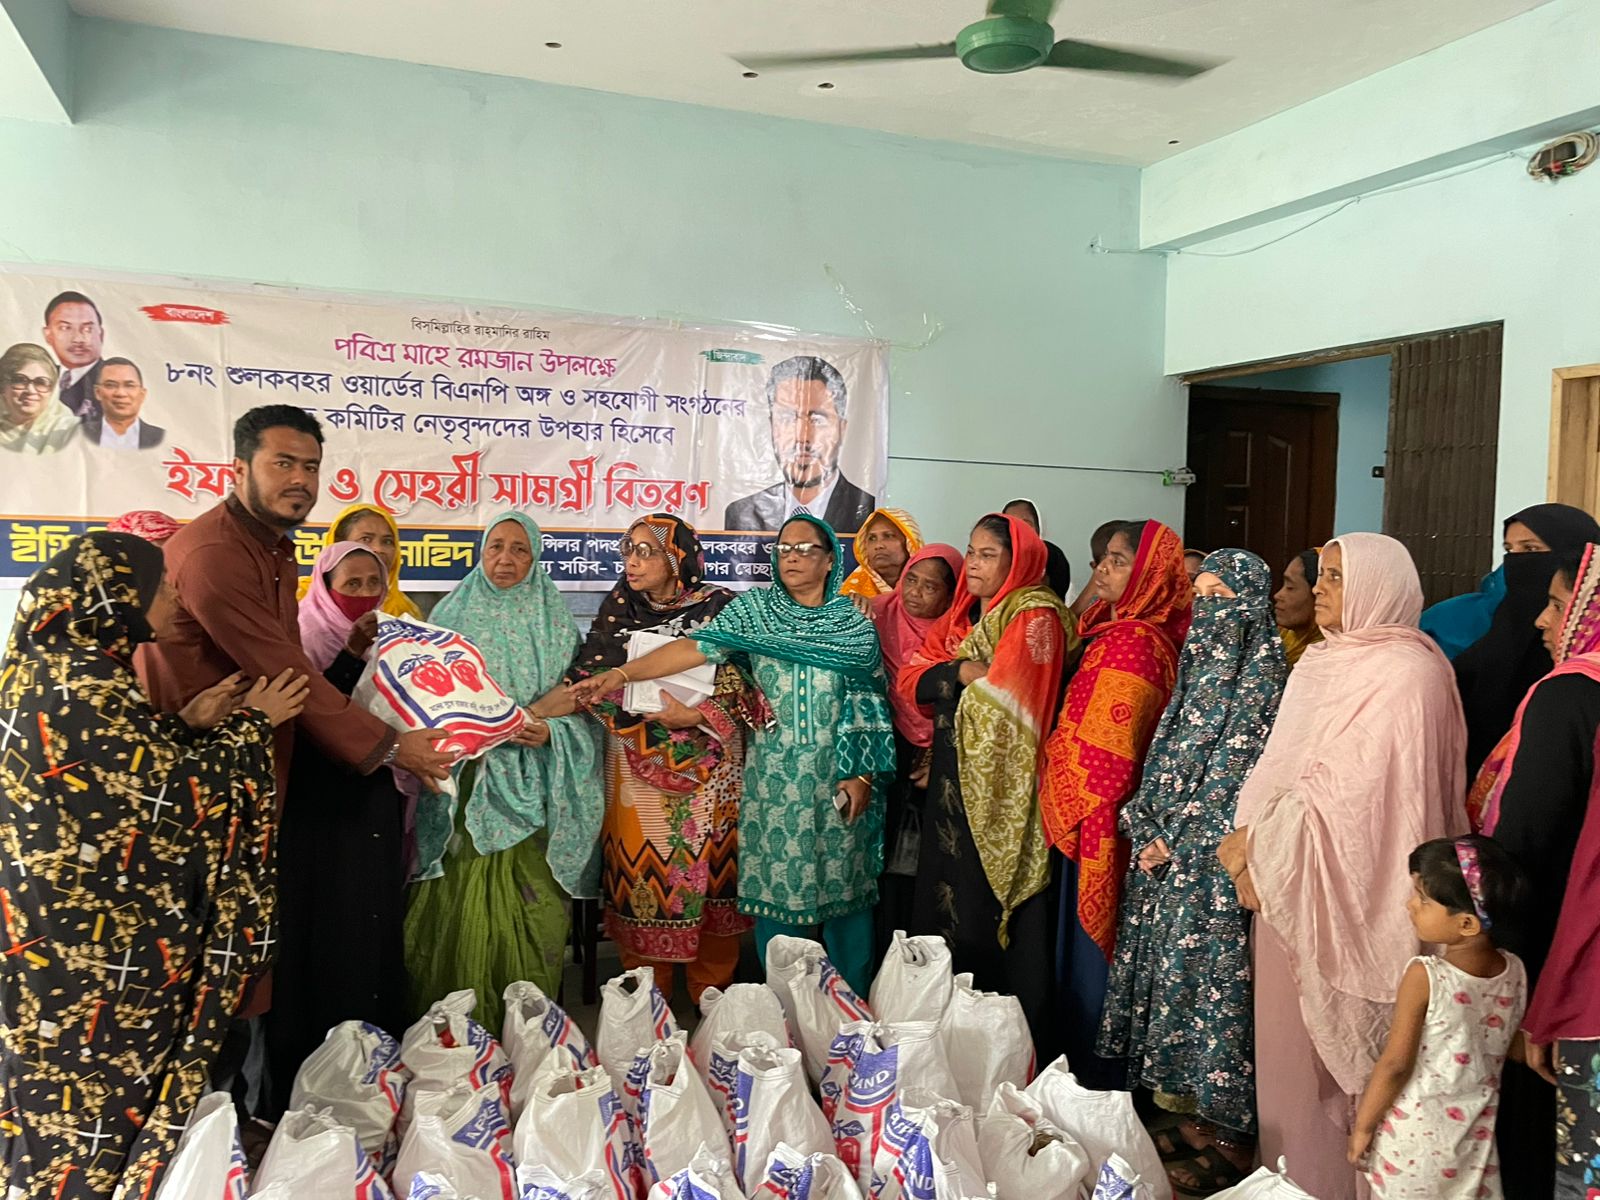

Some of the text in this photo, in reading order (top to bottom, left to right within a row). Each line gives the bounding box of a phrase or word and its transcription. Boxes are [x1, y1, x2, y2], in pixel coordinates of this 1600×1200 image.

[522, 326, 551, 340] রাহিম
[335, 333, 617, 378] পবিত্র মাহে রমজান উপলক্ষে
[166, 363, 747, 418] ৮নং শুলকবহর ওয়ার্ডের বিএনপি অঙ্গ ও সহযোগী সংগঠনের
[323, 402, 676, 446] কমিটির নেতৃবৃন্দদের উপহার হিসেবে
[328, 468, 361, 501] ও
[373, 449, 484, 514] সেহরী
[488, 455, 600, 512] সামগ্রী
[603, 461, 711, 513] বিতরণ
[699, 541, 758, 555] লকবহর
